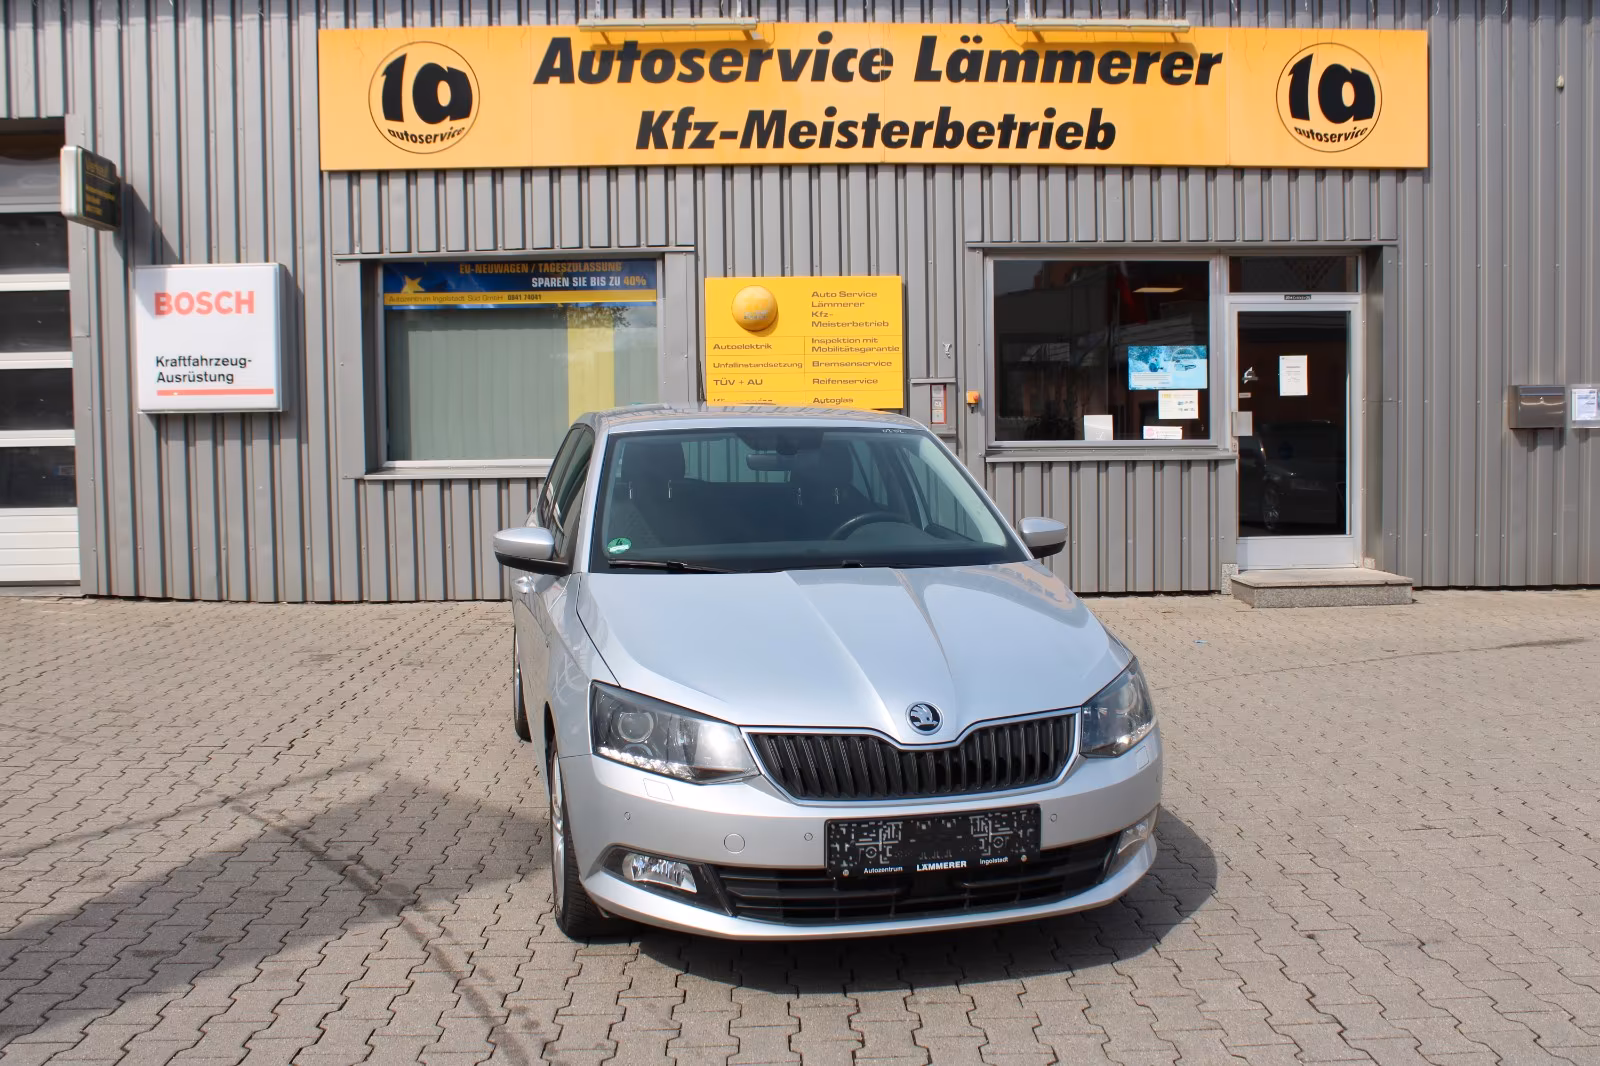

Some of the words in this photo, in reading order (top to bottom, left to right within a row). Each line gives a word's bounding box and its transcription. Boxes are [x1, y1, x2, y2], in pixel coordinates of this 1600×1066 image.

[533, 30, 894, 84] Autoservice
[914, 35, 1223, 85] Lämmerer
[381, 52, 473, 125] 1a
[1288, 53, 1376, 124] 1a
[635, 106, 1116, 150] Kfz-Meisterbetrieb
[1294, 126, 1368, 143] autoservice
[387, 126, 465, 144] autoservice
[459, 263, 529, 274] EU-NEUWAGEN
[538, 261, 623, 273] TAGESZULASSUNG
[531, 277, 570, 288] SPAREN
[572, 277, 588, 287] SIE
[590, 276, 606, 287] BIS
[609, 276, 621, 286] ZU
[623, 276, 647, 286] 40%
[154, 290, 255, 316] BOSCH
[388, 295, 431, 303] Autozentrum
[432, 295, 465, 303] Ingolstadt
[811, 320, 889, 328] Meisterbetrieb
[811, 346, 900, 354] Mobilitätsgarantie
[156, 355, 252, 369] Kraftfahrzeug-
[713, 361, 803, 369] Unfallinstandsetzung
[812, 360, 892, 368] Bremsenservice
[156, 371, 235, 384] Ausrüstung
[713, 377, 736, 386] TÜV
[812, 397, 854, 405] Autoglas
[863, 866, 903, 875] Autozentrum
[916, 860, 967, 872] LÄMMERER
[979, 856, 1009, 866] Ingolstadt
